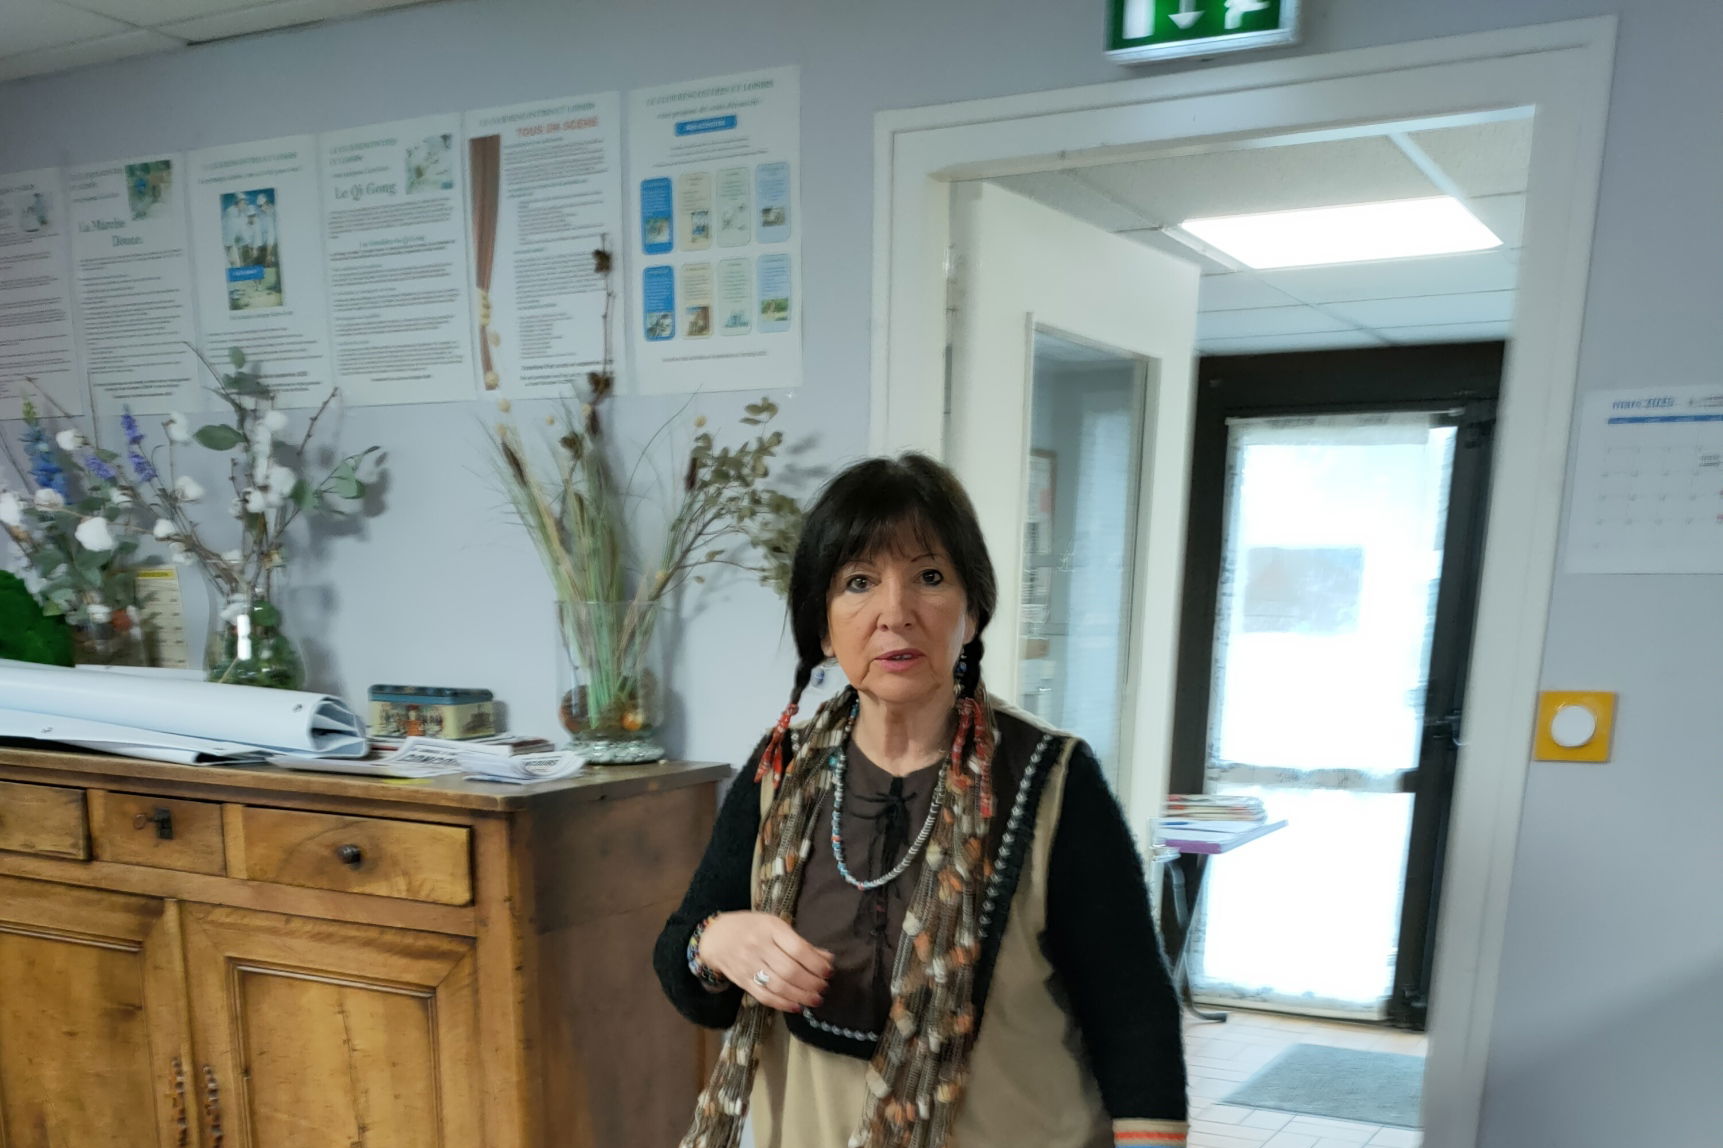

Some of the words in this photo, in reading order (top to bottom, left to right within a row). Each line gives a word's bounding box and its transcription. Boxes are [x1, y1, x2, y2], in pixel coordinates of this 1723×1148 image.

[516, 125, 543, 138] TOUS
[334, 186, 348, 200] Le
[366, 182, 397, 197] Gong
